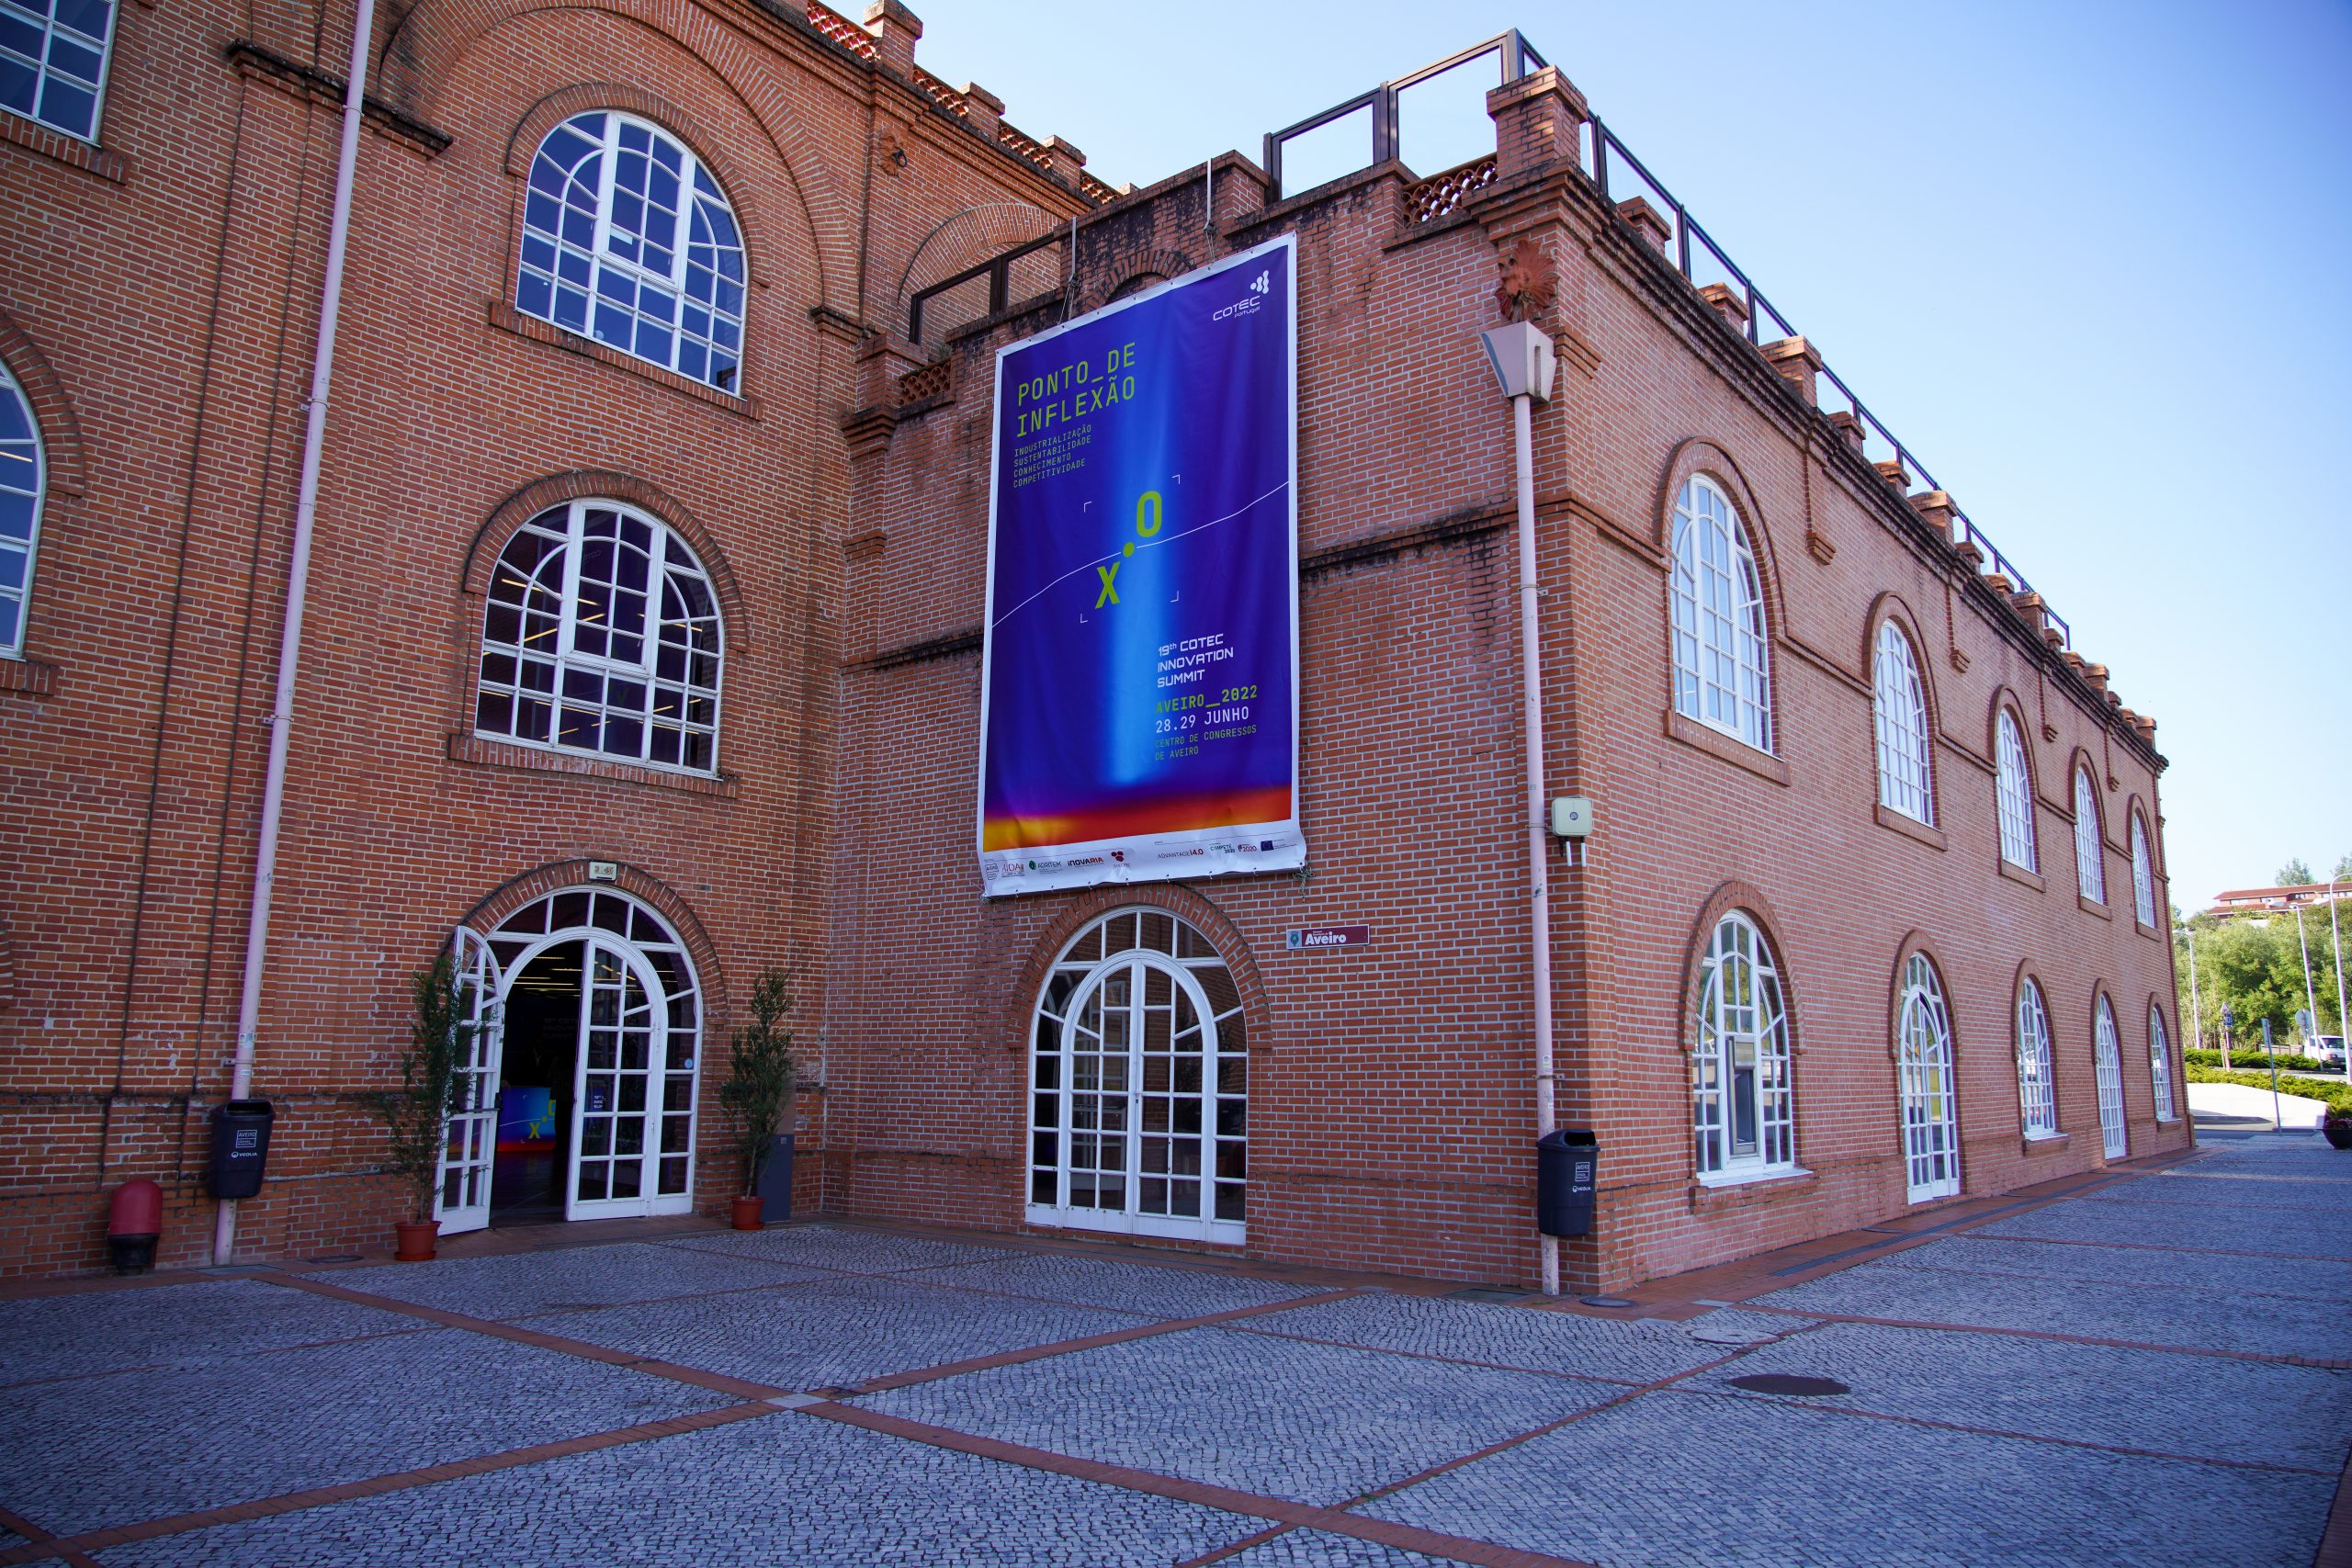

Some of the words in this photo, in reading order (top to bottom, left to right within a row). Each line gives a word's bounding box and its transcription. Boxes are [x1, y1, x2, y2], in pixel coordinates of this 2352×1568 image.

[1213, 295, 1260, 321] COTEC
[1016, 375, 1135, 437] INFLEXÃO
[1013, 434, 1091, 468] SUSTENTABILIDADE
[1014, 424, 1091, 457] INDUSTRIALIZAÇÃO
[1013, 452, 1071, 478] CONHECIMENTO
[1013, 457, 1086, 489] COMPETITIVIDADE
[1158, 643, 1177, 657] 19th
[1180, 633, 1224, 652] COTEC
[1158, 647, 1234, 673] INNOVATION
[1157, 669, 1205, 688] SUMMIT
[1156, 714, 1196, 733] 28.29
[1204, 705, 1250, 725] JUNHO
[1155, 736, 1184, 749] CENTRO
[1189, 733, 1199, 743] DE
[1204, 724, 1257, 740] CONGRESSOS
[1155, 751, 1164, 761] DE
[1170, 746, 1199, 759] AVEIRO
[1305, 931, 1347, 945] Aveiro
